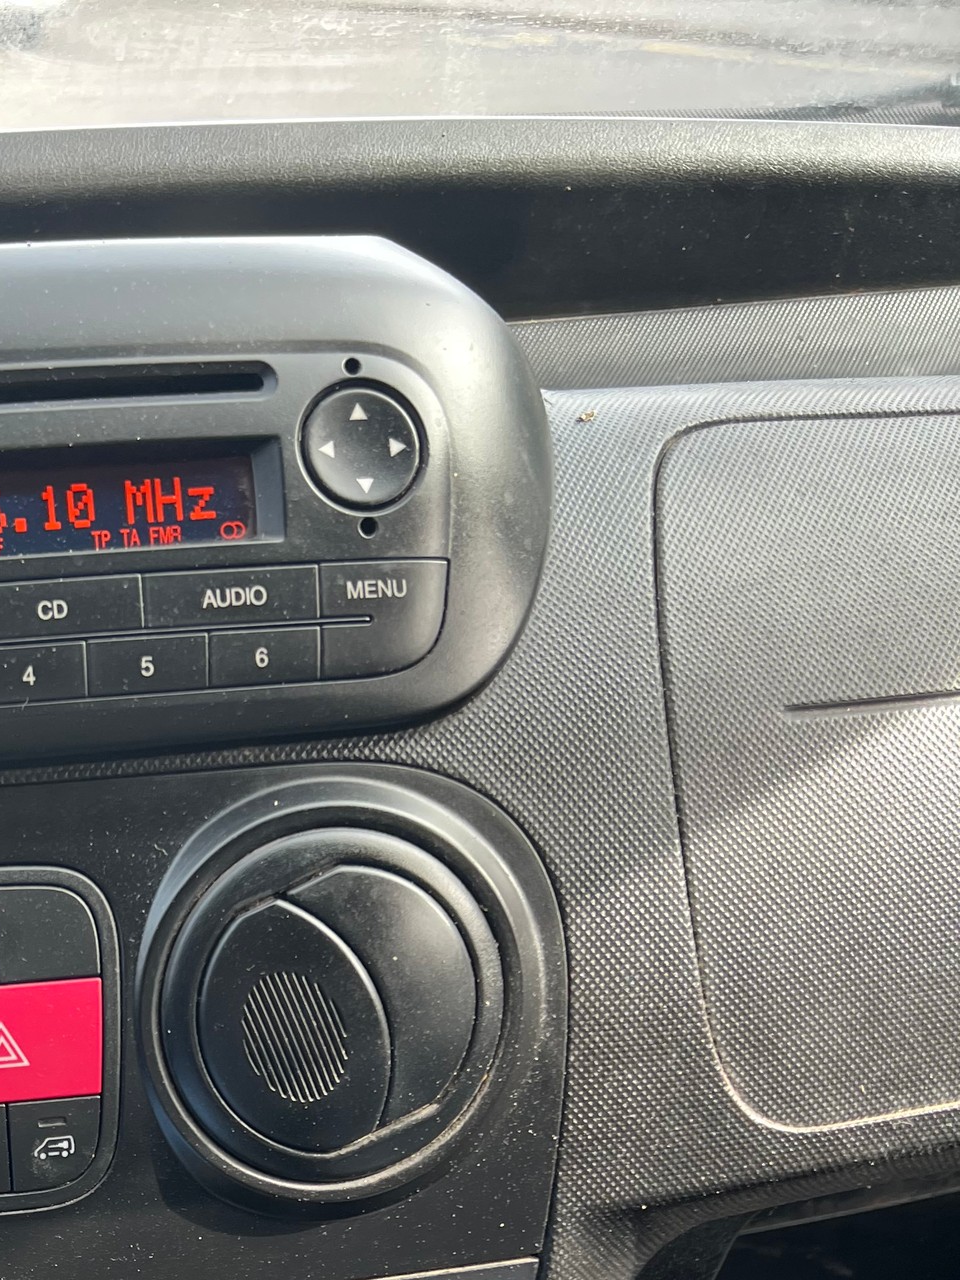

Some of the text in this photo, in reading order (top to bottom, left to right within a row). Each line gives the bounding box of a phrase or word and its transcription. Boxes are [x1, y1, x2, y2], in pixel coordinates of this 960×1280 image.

[124, 476, 217, 526] MHz
[91, 530, 111, 551] TP
[120, 528, 141, 549] TA
[202, 585, 268, 609] AUDIO
[346, 578, 408, 600] MENU
[37, 600, 68, 621] CD
[140, 656, 155, 677] 5
[255, 647, 269, 668] 6
[22, 665, 36, 686] 4
